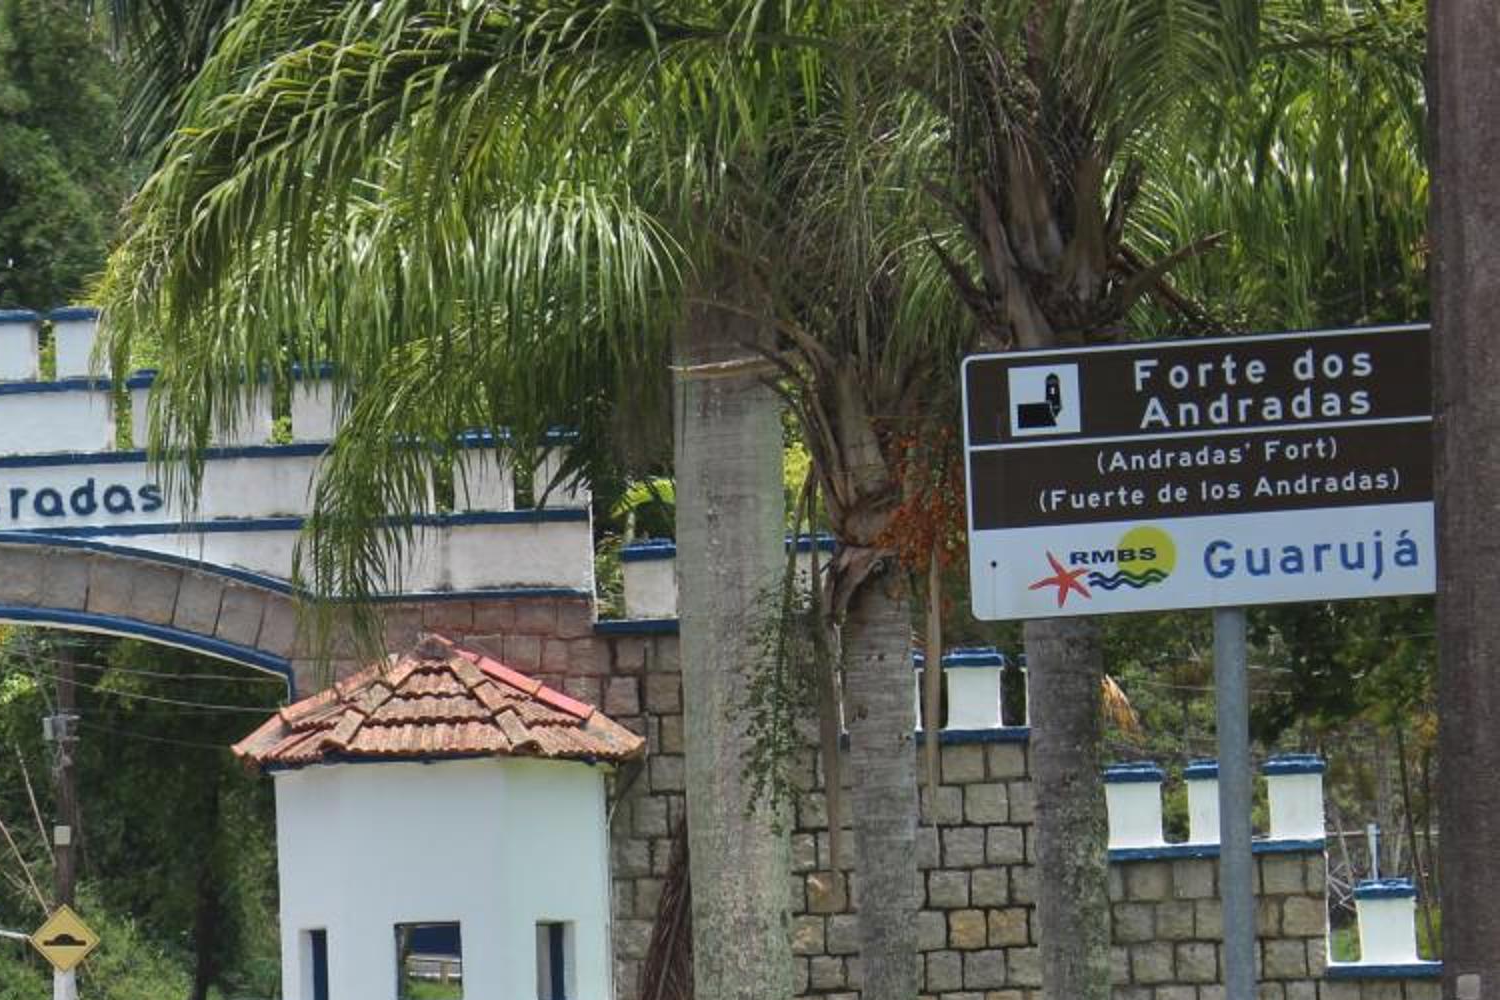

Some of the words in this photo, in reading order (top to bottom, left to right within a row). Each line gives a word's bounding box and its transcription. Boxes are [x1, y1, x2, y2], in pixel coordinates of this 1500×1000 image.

[1133, 357, 1267, 391] Forte
[1292, 350, 1374, 383] dos
[1140, 388, 1372, 429] Andradas
[1264, 436, 1338, 463] Fort)
[1038, 486, 1145, 513] (Fuerte
[1157, 483, 1189, 504] de
[1200, 482, 1244, 502] los
[1254, 467, 1401, 498] Andradas)
[1069, 546, 1157, 566] RMBS
[1203, 529, 1420, 581] Guarujá
